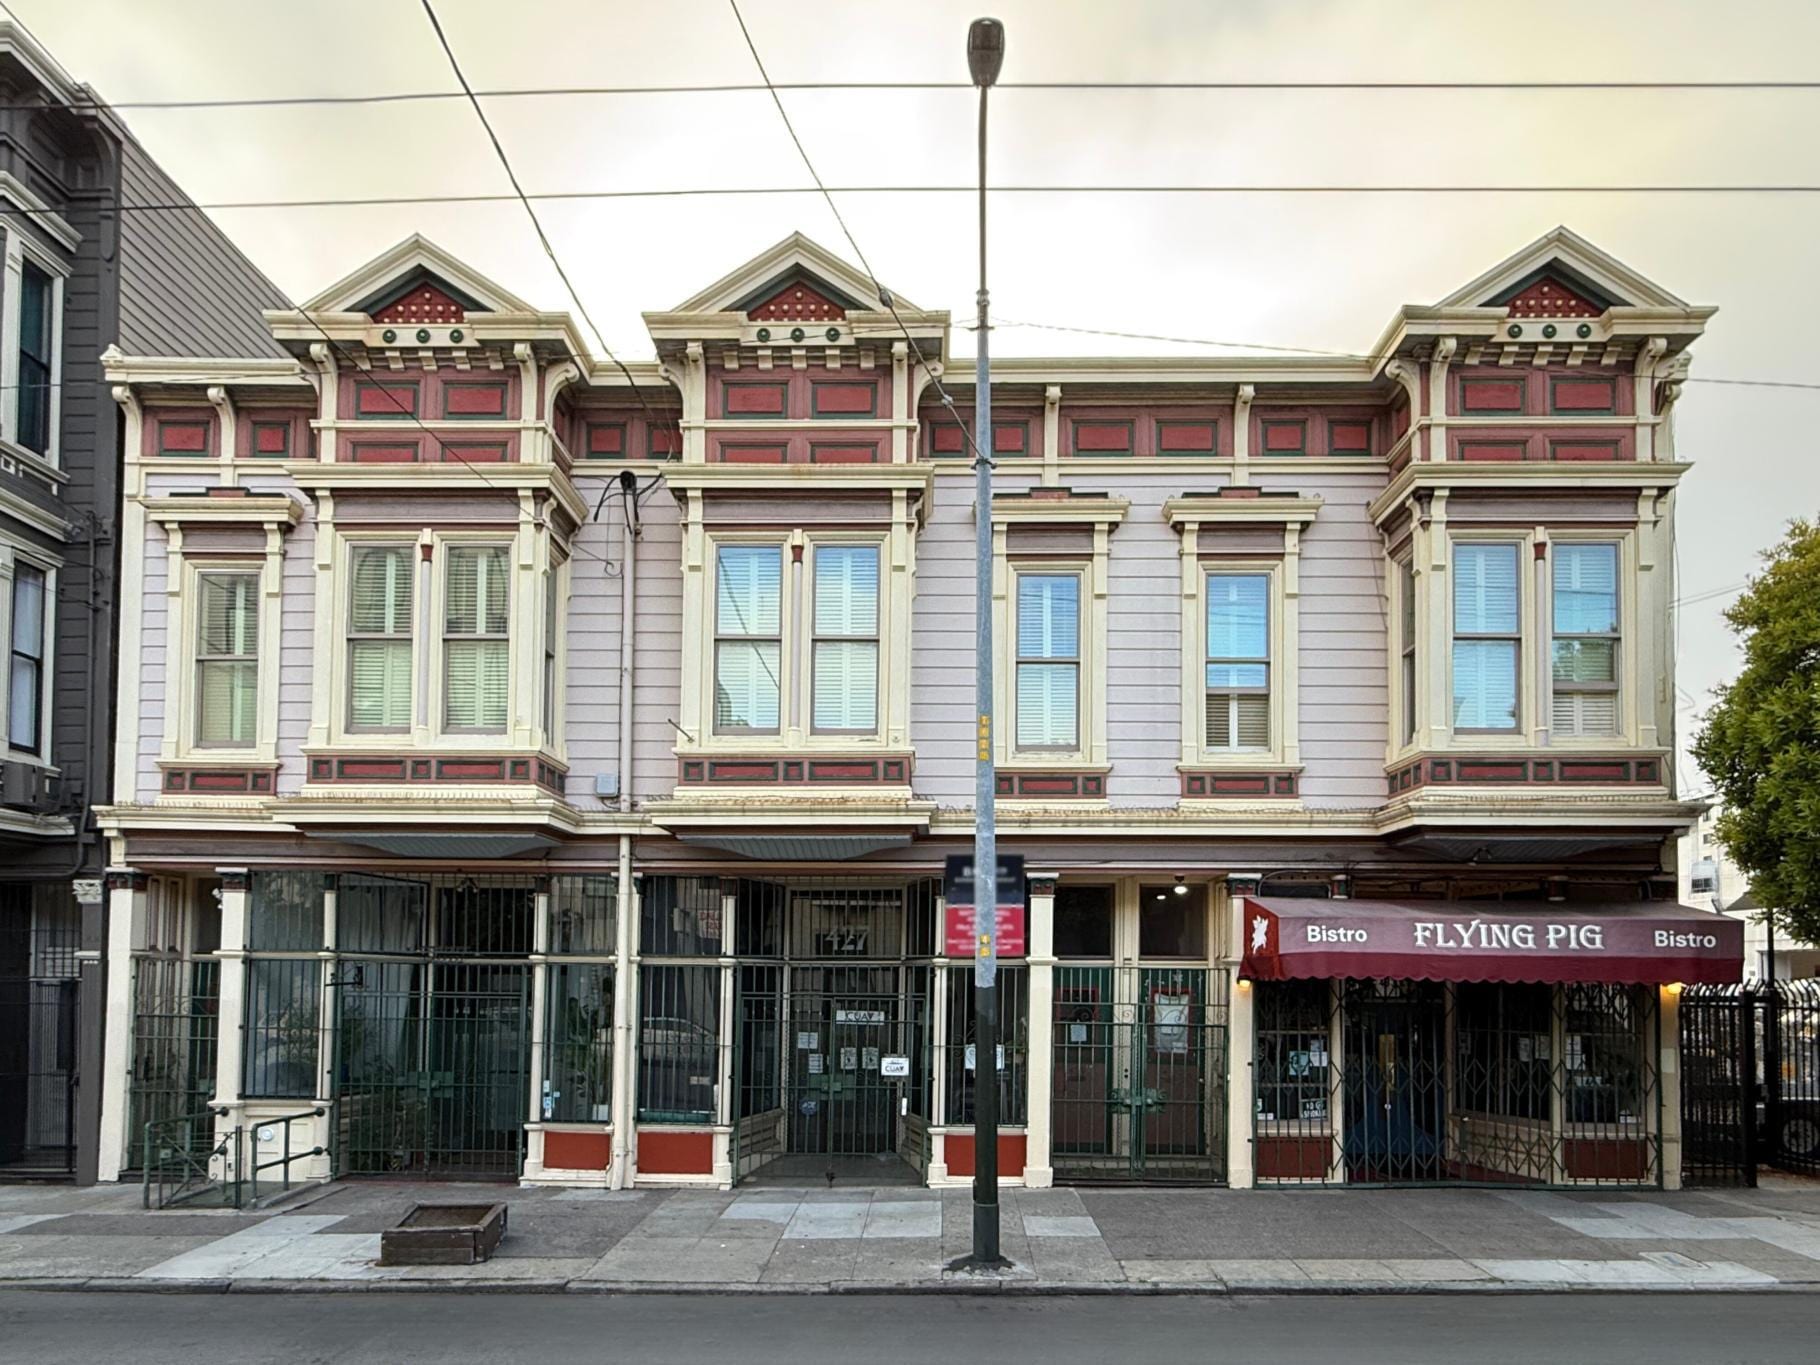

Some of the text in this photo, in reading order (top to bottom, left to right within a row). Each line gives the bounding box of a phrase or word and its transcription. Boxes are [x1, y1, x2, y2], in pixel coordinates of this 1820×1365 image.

[824, 926, 870, 951] 427
[1306, 925, 1368, 943] Bistro
[1413, 919, 1606, 950] FLYING PIG
[1654, 930, 1717, 949] Bistro
